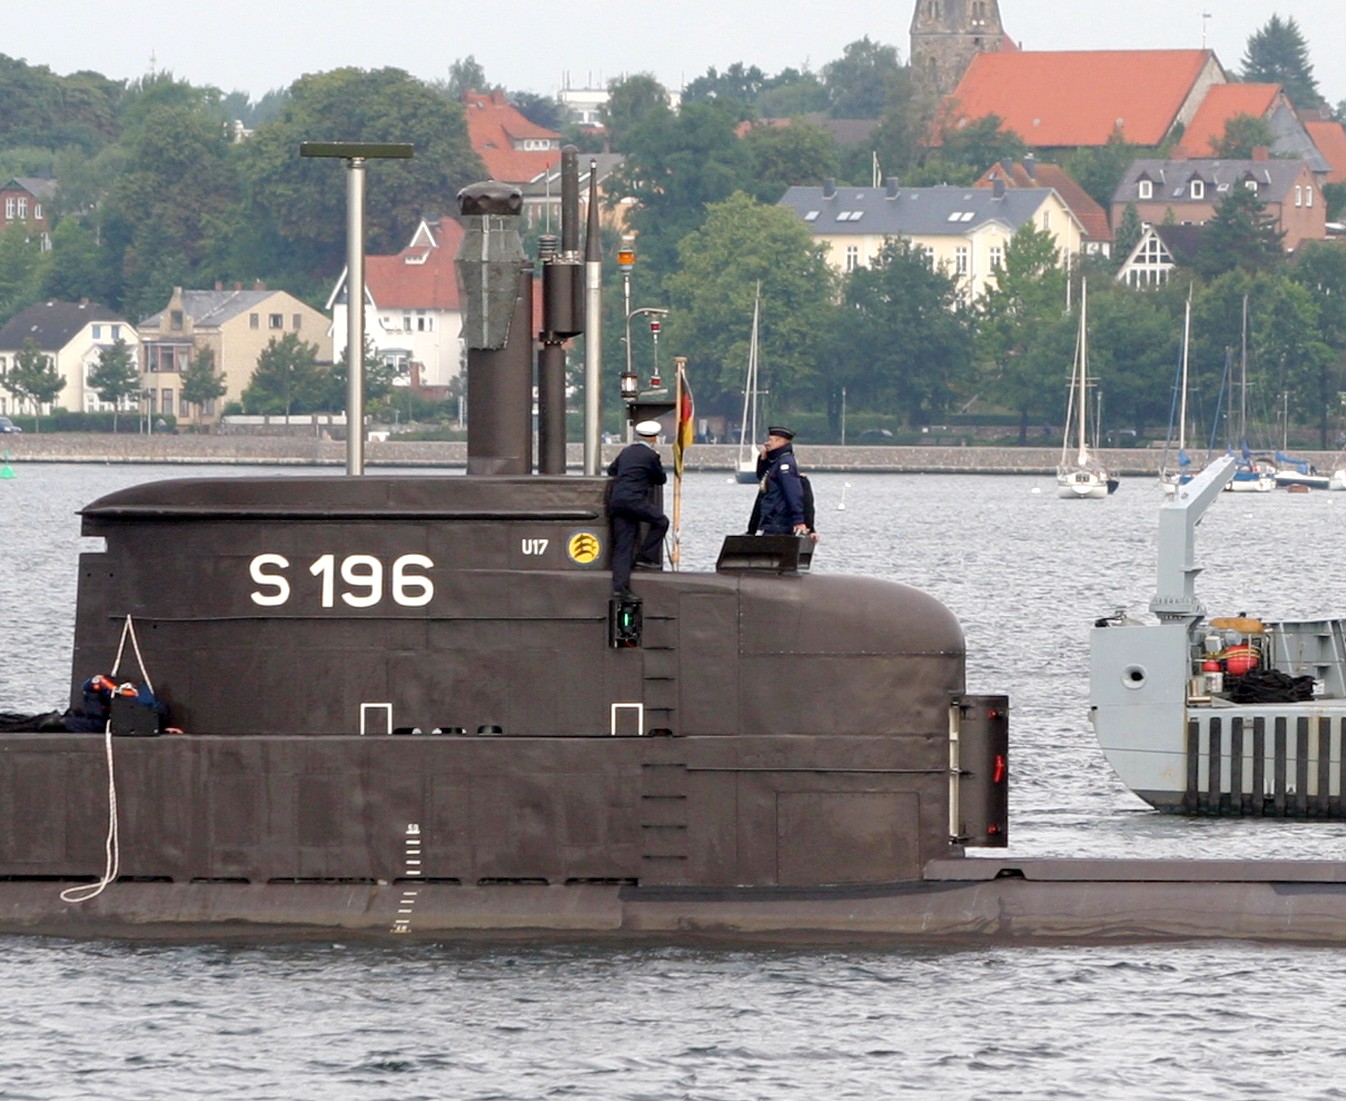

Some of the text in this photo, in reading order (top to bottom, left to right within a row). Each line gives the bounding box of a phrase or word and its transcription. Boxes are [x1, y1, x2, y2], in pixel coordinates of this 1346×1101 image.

[521, 538, 548, 555] U17
[249, 553, 435, 608] S 196
